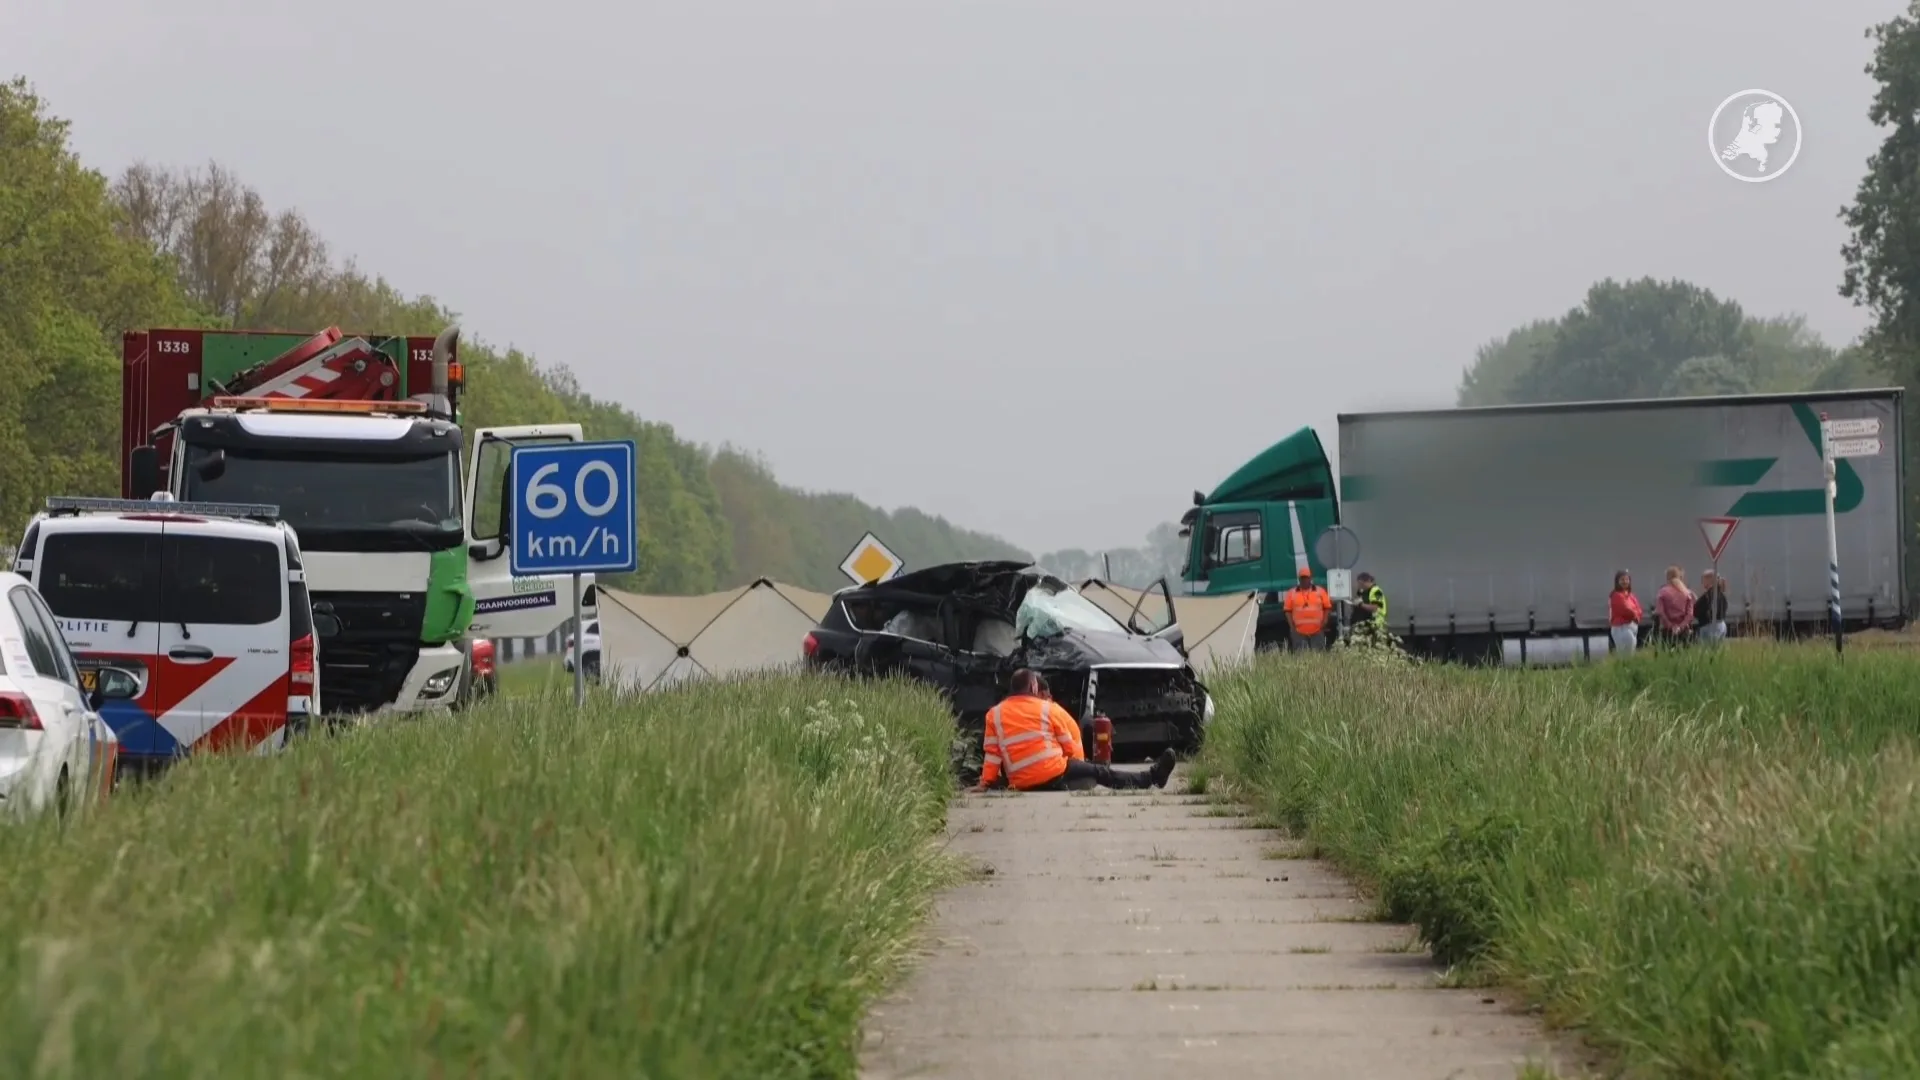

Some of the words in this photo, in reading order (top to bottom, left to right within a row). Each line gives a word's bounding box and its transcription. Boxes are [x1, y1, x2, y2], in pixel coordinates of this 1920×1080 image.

[157, 340, 190, 354] 1338
[412, 349, 433, 361] 133
[525, 459, 619, 519] 60
[527, 525, 619, 558] km/h
[56, 620, 109, 633] OLITIE
